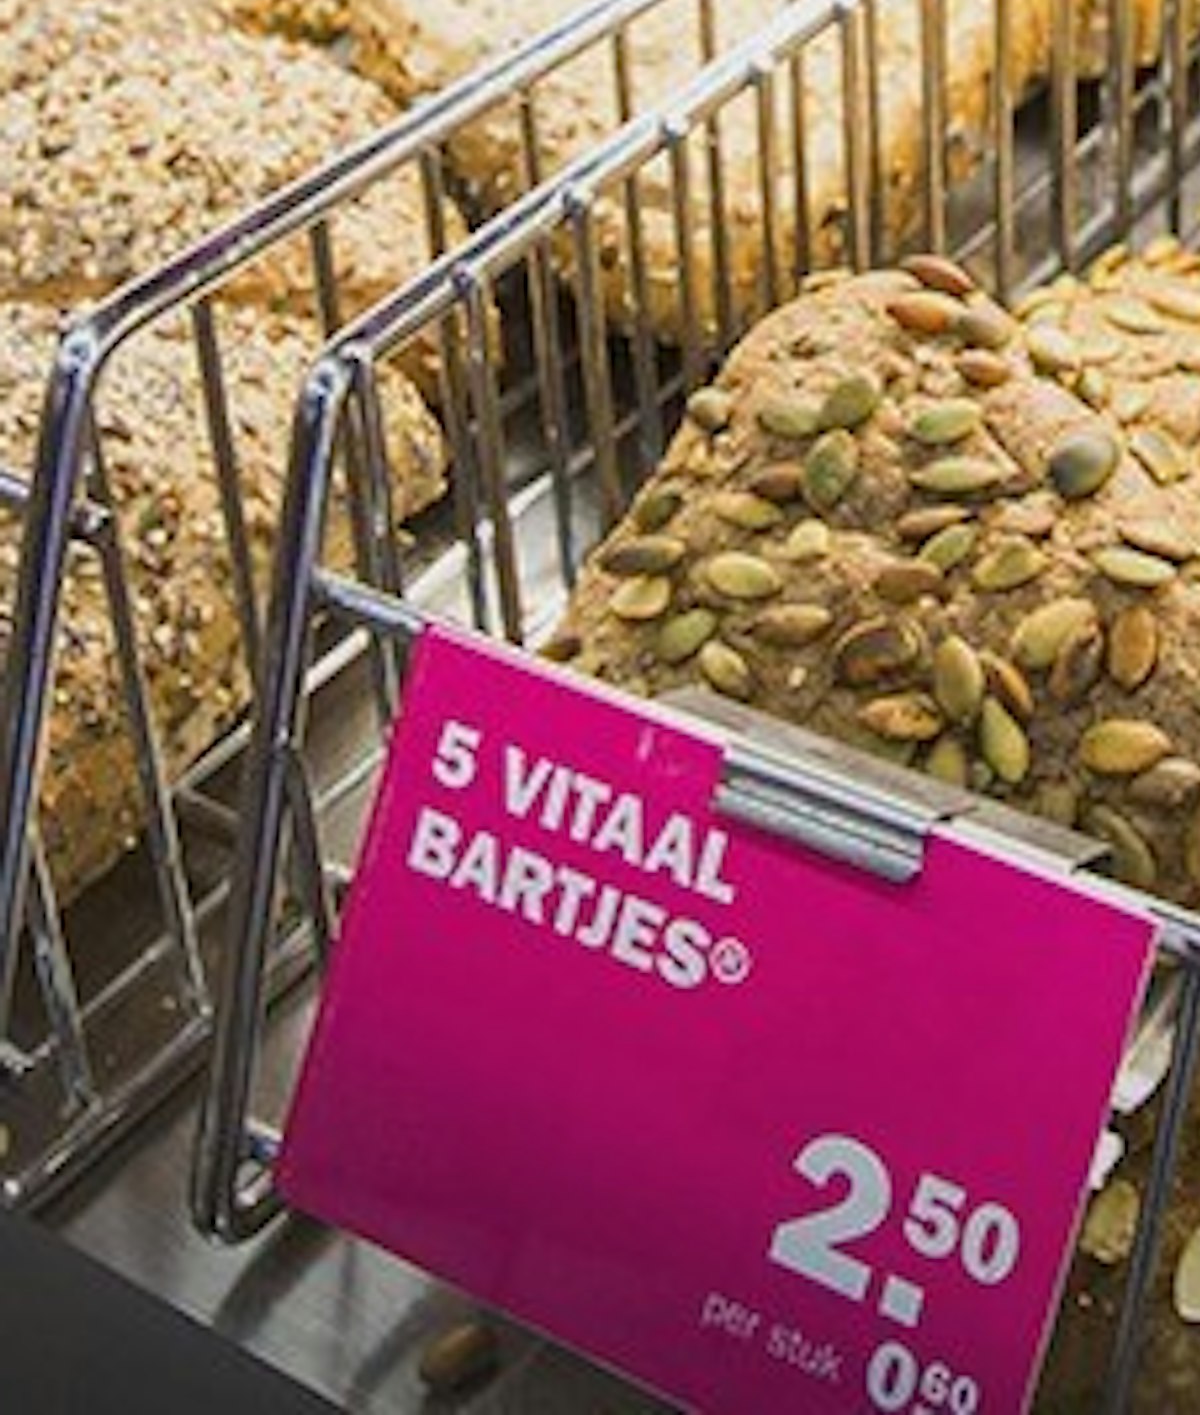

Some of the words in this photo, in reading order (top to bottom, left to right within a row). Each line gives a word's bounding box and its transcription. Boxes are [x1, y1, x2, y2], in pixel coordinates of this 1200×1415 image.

[432, 719, 481, 789] 5
[505, 744, 735, 905] VITAAL
[768, 1134, 1020, 1328] 2.50
[701, 1292, 761, 1337] per
[766, 1323, 842, 1381] stuk
